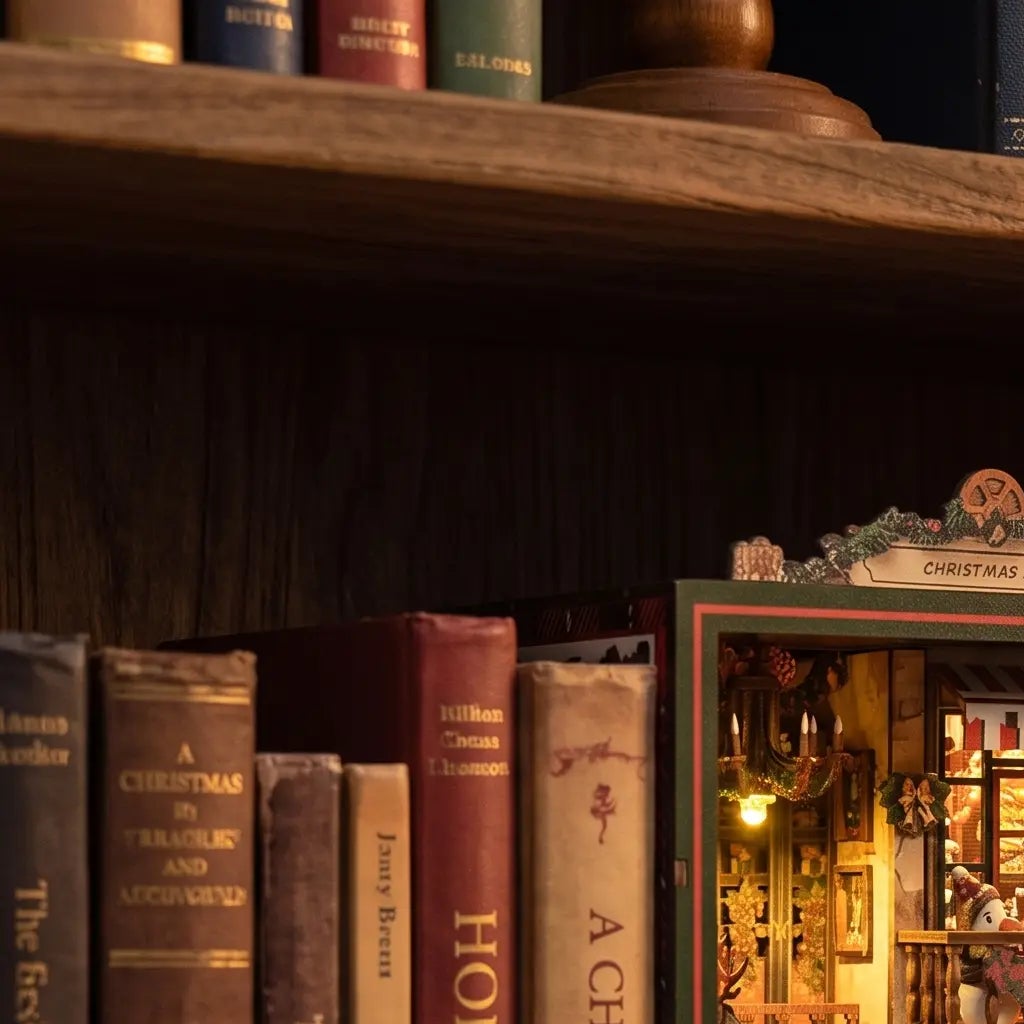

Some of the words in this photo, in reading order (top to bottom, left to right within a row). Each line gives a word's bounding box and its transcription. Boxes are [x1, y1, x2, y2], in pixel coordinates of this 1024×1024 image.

[923, 561, 1018, 579] CHRISTMAS
[177, 743, 195, 765] A
[119, 770, 244, 795] CHRISTMAS
[14, 879, 48, 952] The
[589, 908, 625, 945] A
